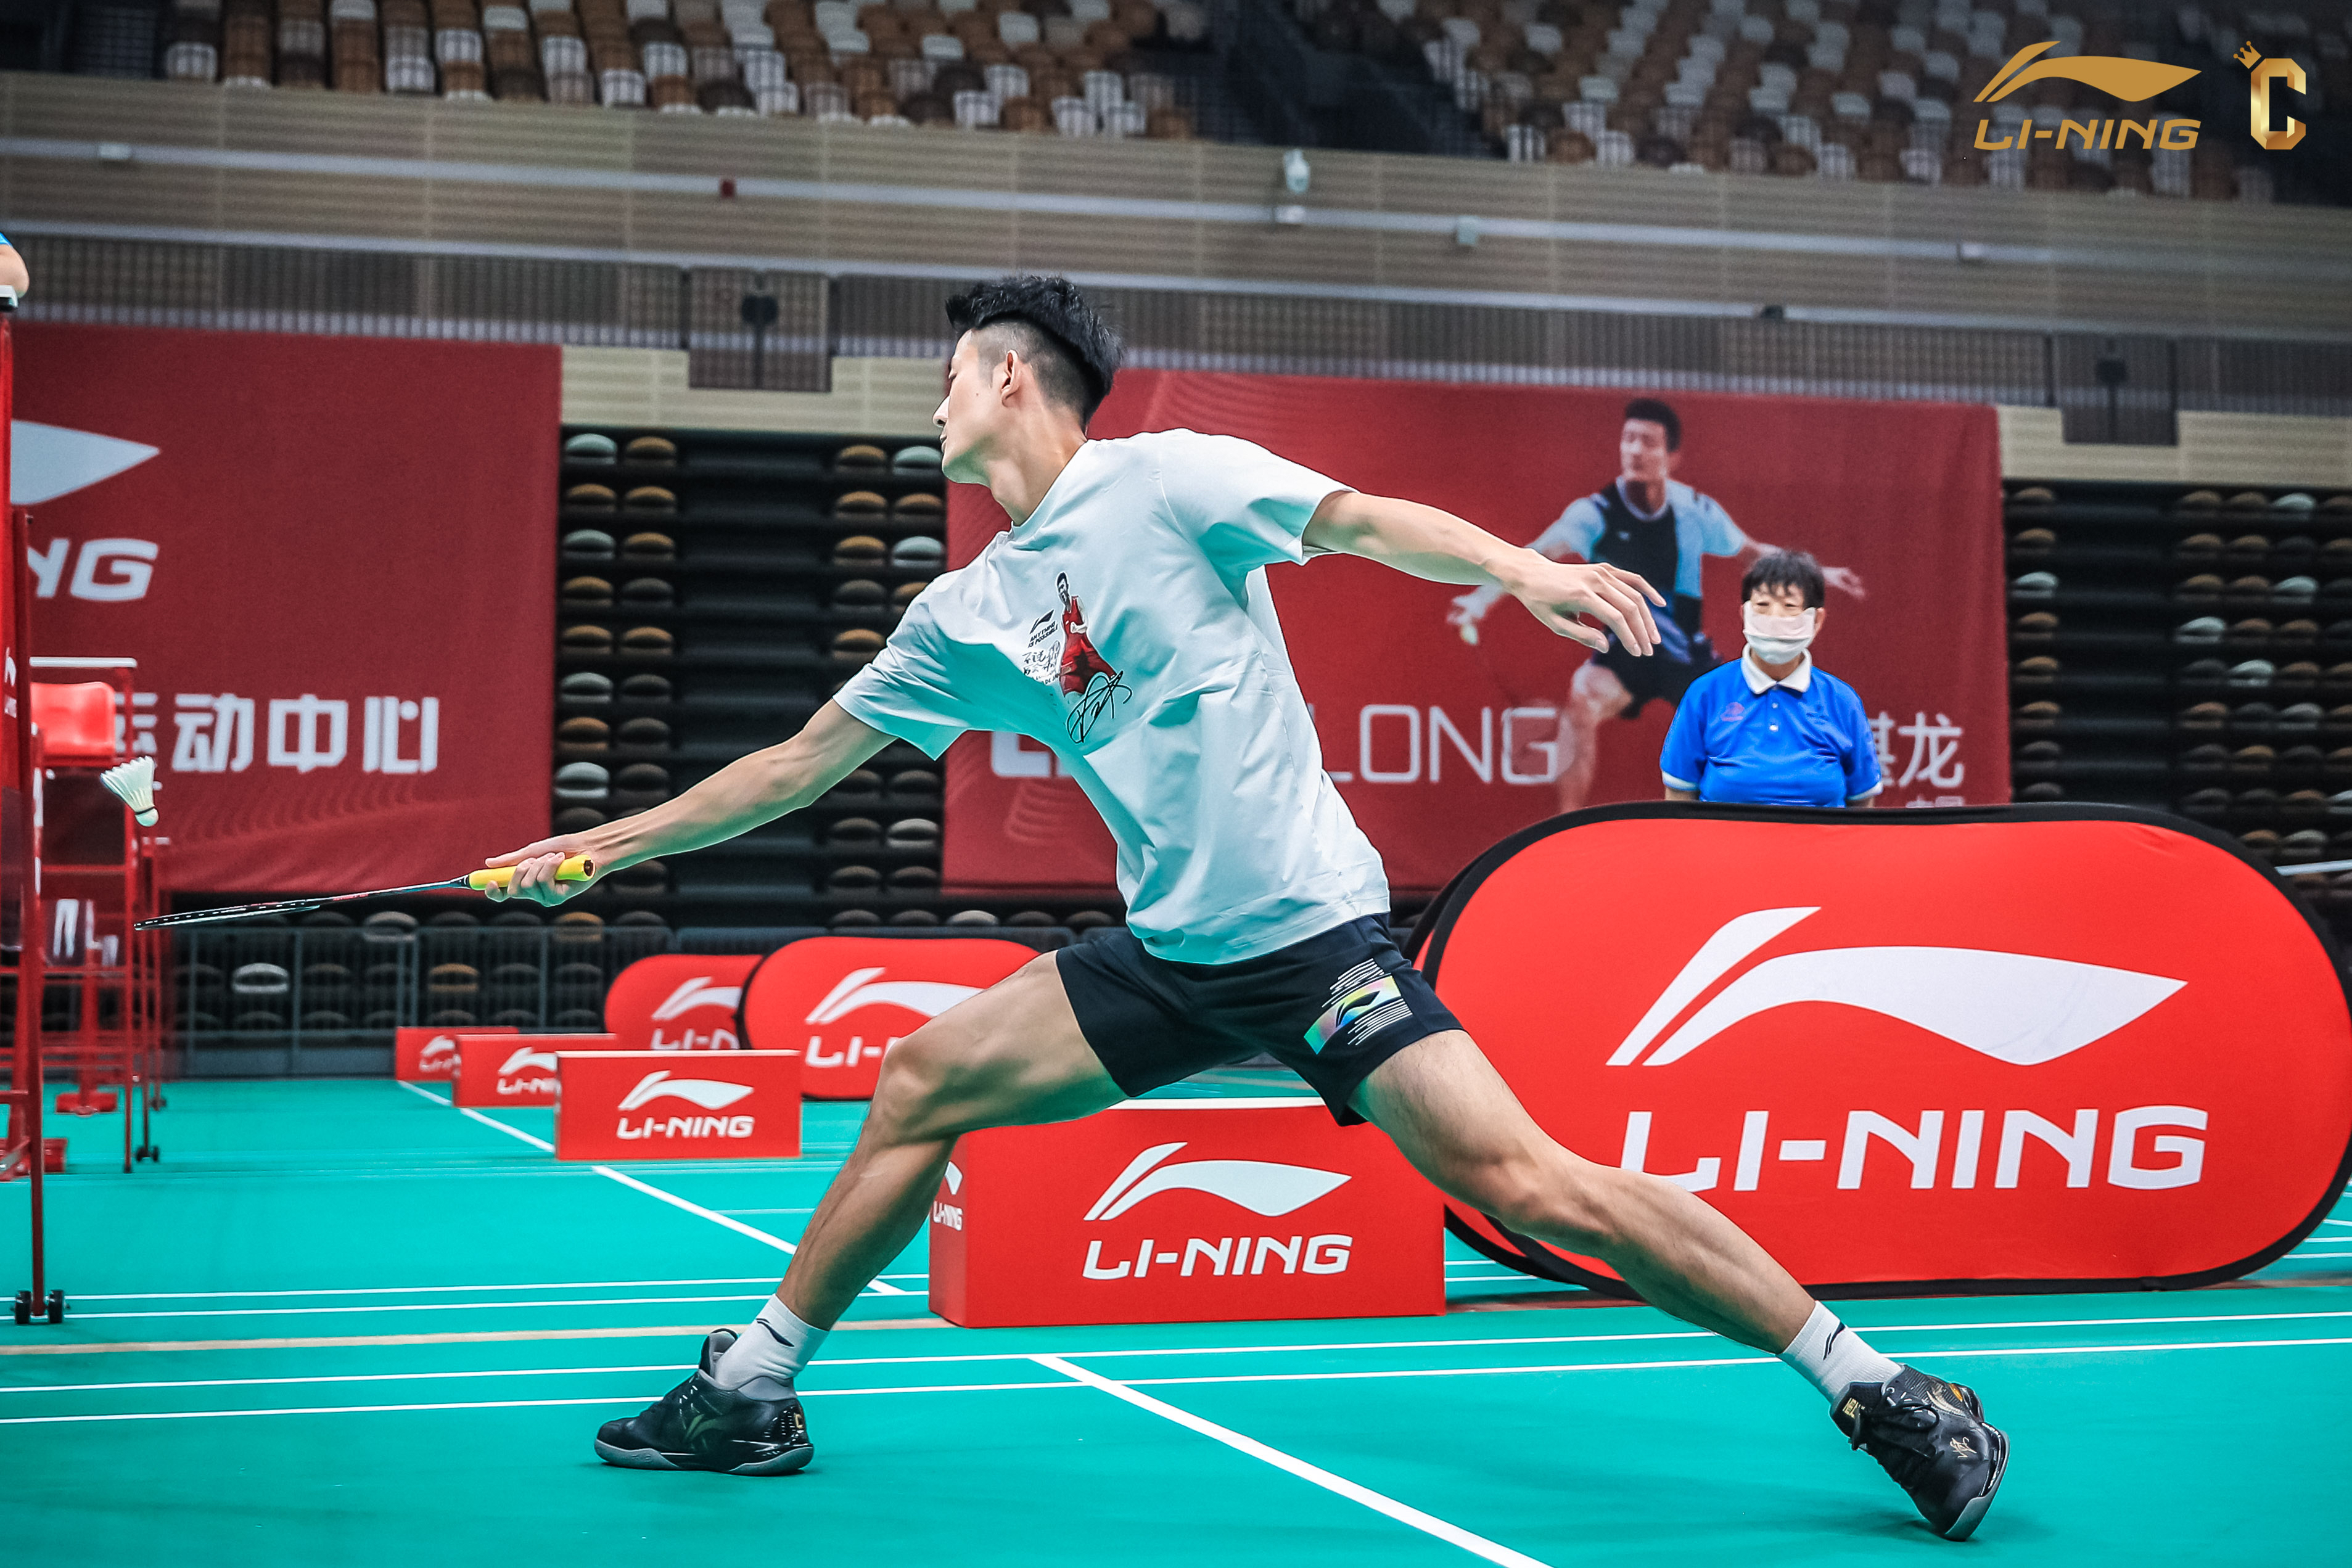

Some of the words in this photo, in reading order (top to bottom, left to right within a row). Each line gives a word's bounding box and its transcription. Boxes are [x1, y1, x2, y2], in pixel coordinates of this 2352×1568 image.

[617, 1116, 754, 1139] LI-NING
[1619, 1104, 2209, 1193] LI-NING
[1082, 1234, 1353, 1280] LI-NING
